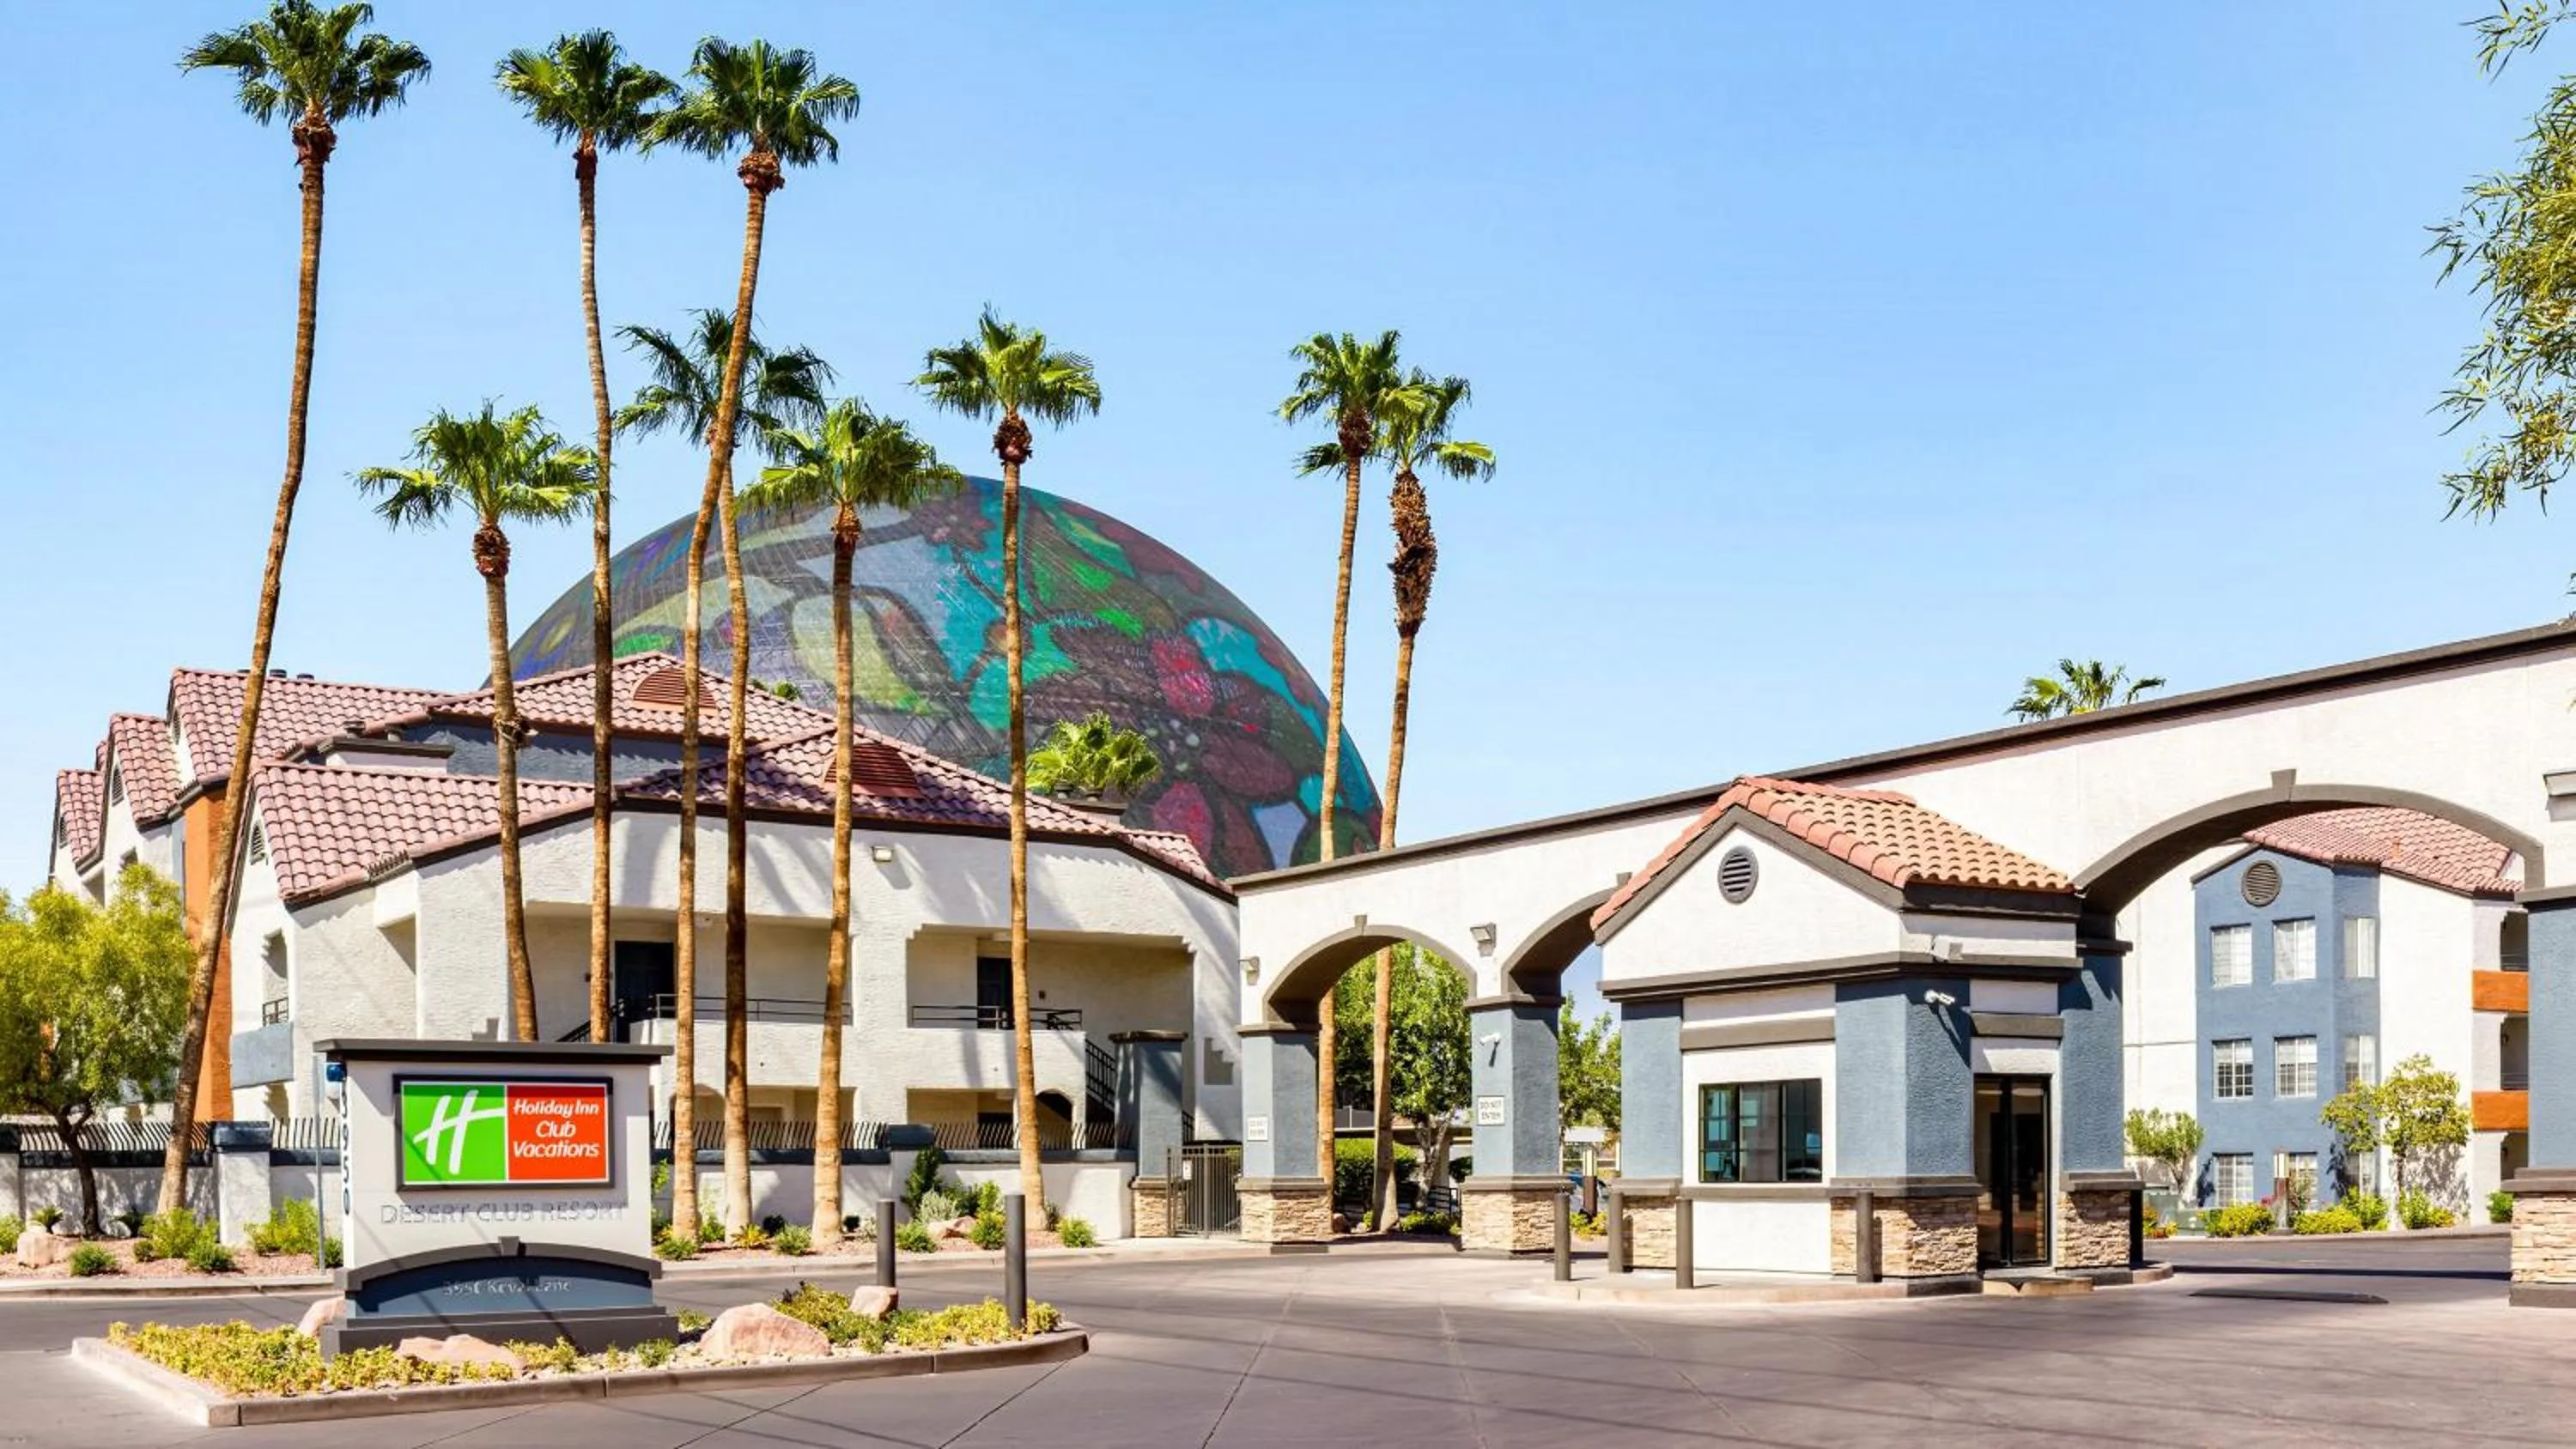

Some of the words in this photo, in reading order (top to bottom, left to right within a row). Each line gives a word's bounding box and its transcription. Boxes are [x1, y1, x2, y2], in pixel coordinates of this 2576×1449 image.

[513, 1098, 573, 1119] Holiday
[574, 1098, 599, 1115] Inn
[535, 1119, 576, 1138] Club
[513, 1140, 600, 1158] Vacations
[380, 1203, 471, 1223] DESERT
[477, 1203, 534, 1222] CLUB
[540, 1201, 624, 1222] RESORT
